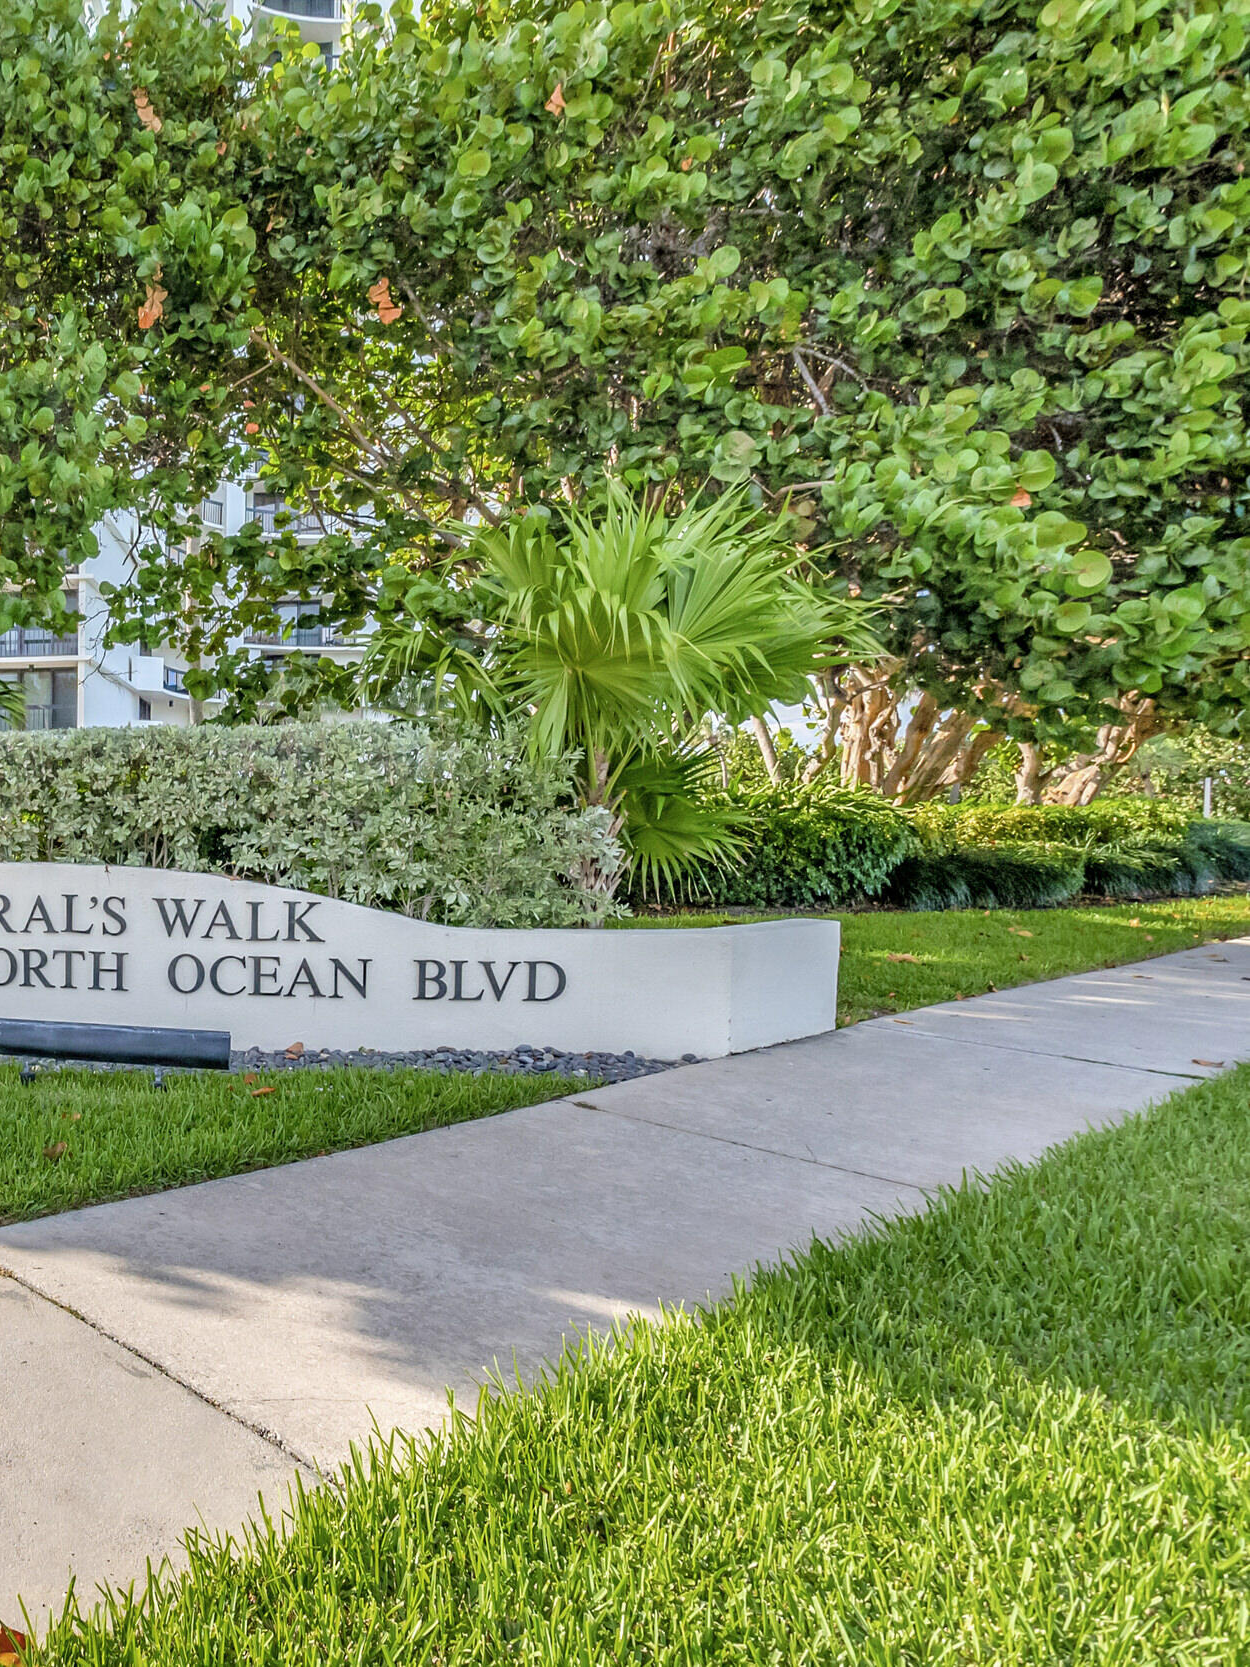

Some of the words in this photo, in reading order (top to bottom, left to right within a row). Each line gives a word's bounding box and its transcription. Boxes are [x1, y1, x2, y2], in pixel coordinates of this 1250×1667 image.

[152, 898, 326, 943] WALK
[168, 954, 373, 999] OCEAN
[412, 960, 567, 1001] BLVD
